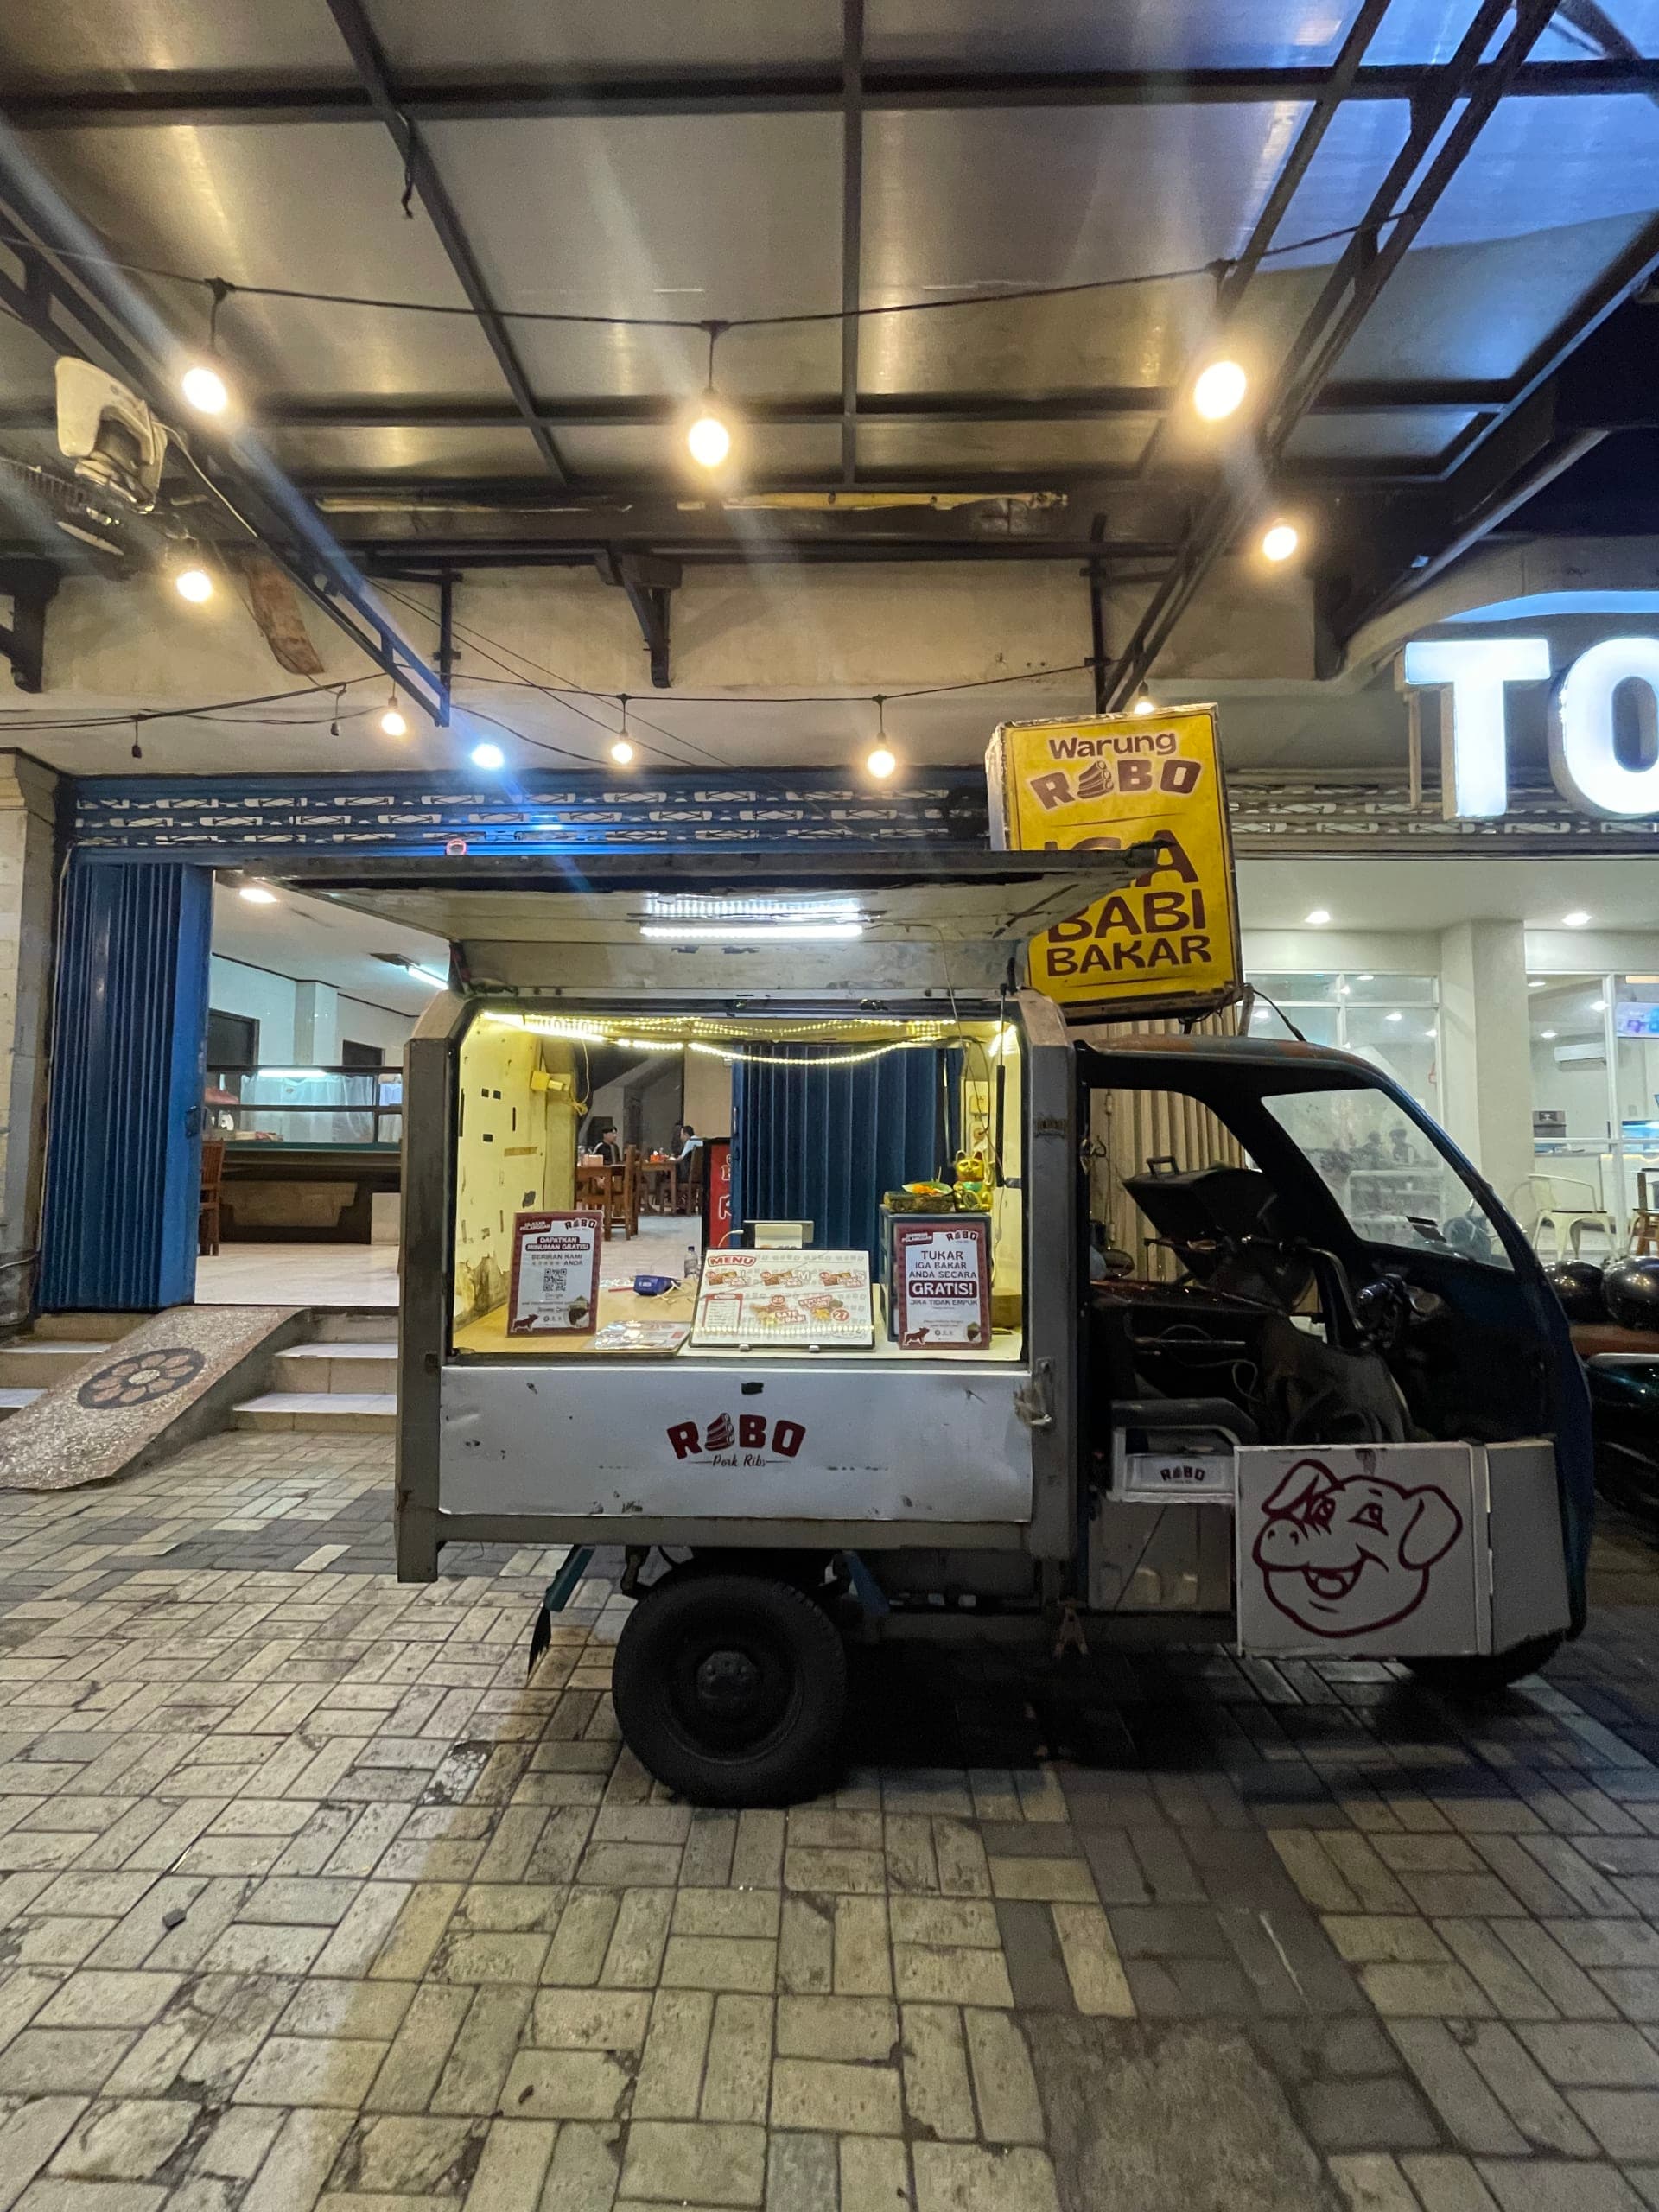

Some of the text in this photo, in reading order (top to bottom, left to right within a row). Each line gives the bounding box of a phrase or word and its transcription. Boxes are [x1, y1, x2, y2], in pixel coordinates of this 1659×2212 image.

[1405, 637, 1659, 817] TO
[1048, 733, 1176, 760] Warung
[1048, 889, 1206, 944] BABI
[1046, 935, 1211, 977] BAKAR
[710, 1256, 753, 1265] MENU
[921, 1250, 964, 1261] TUKAR
[909, 1270, 977, 1279] ANDA SECARA
[912, 1282, 973, 1295] GRATIS!
[712, 1453, 766, 1467] Pork Ribs
